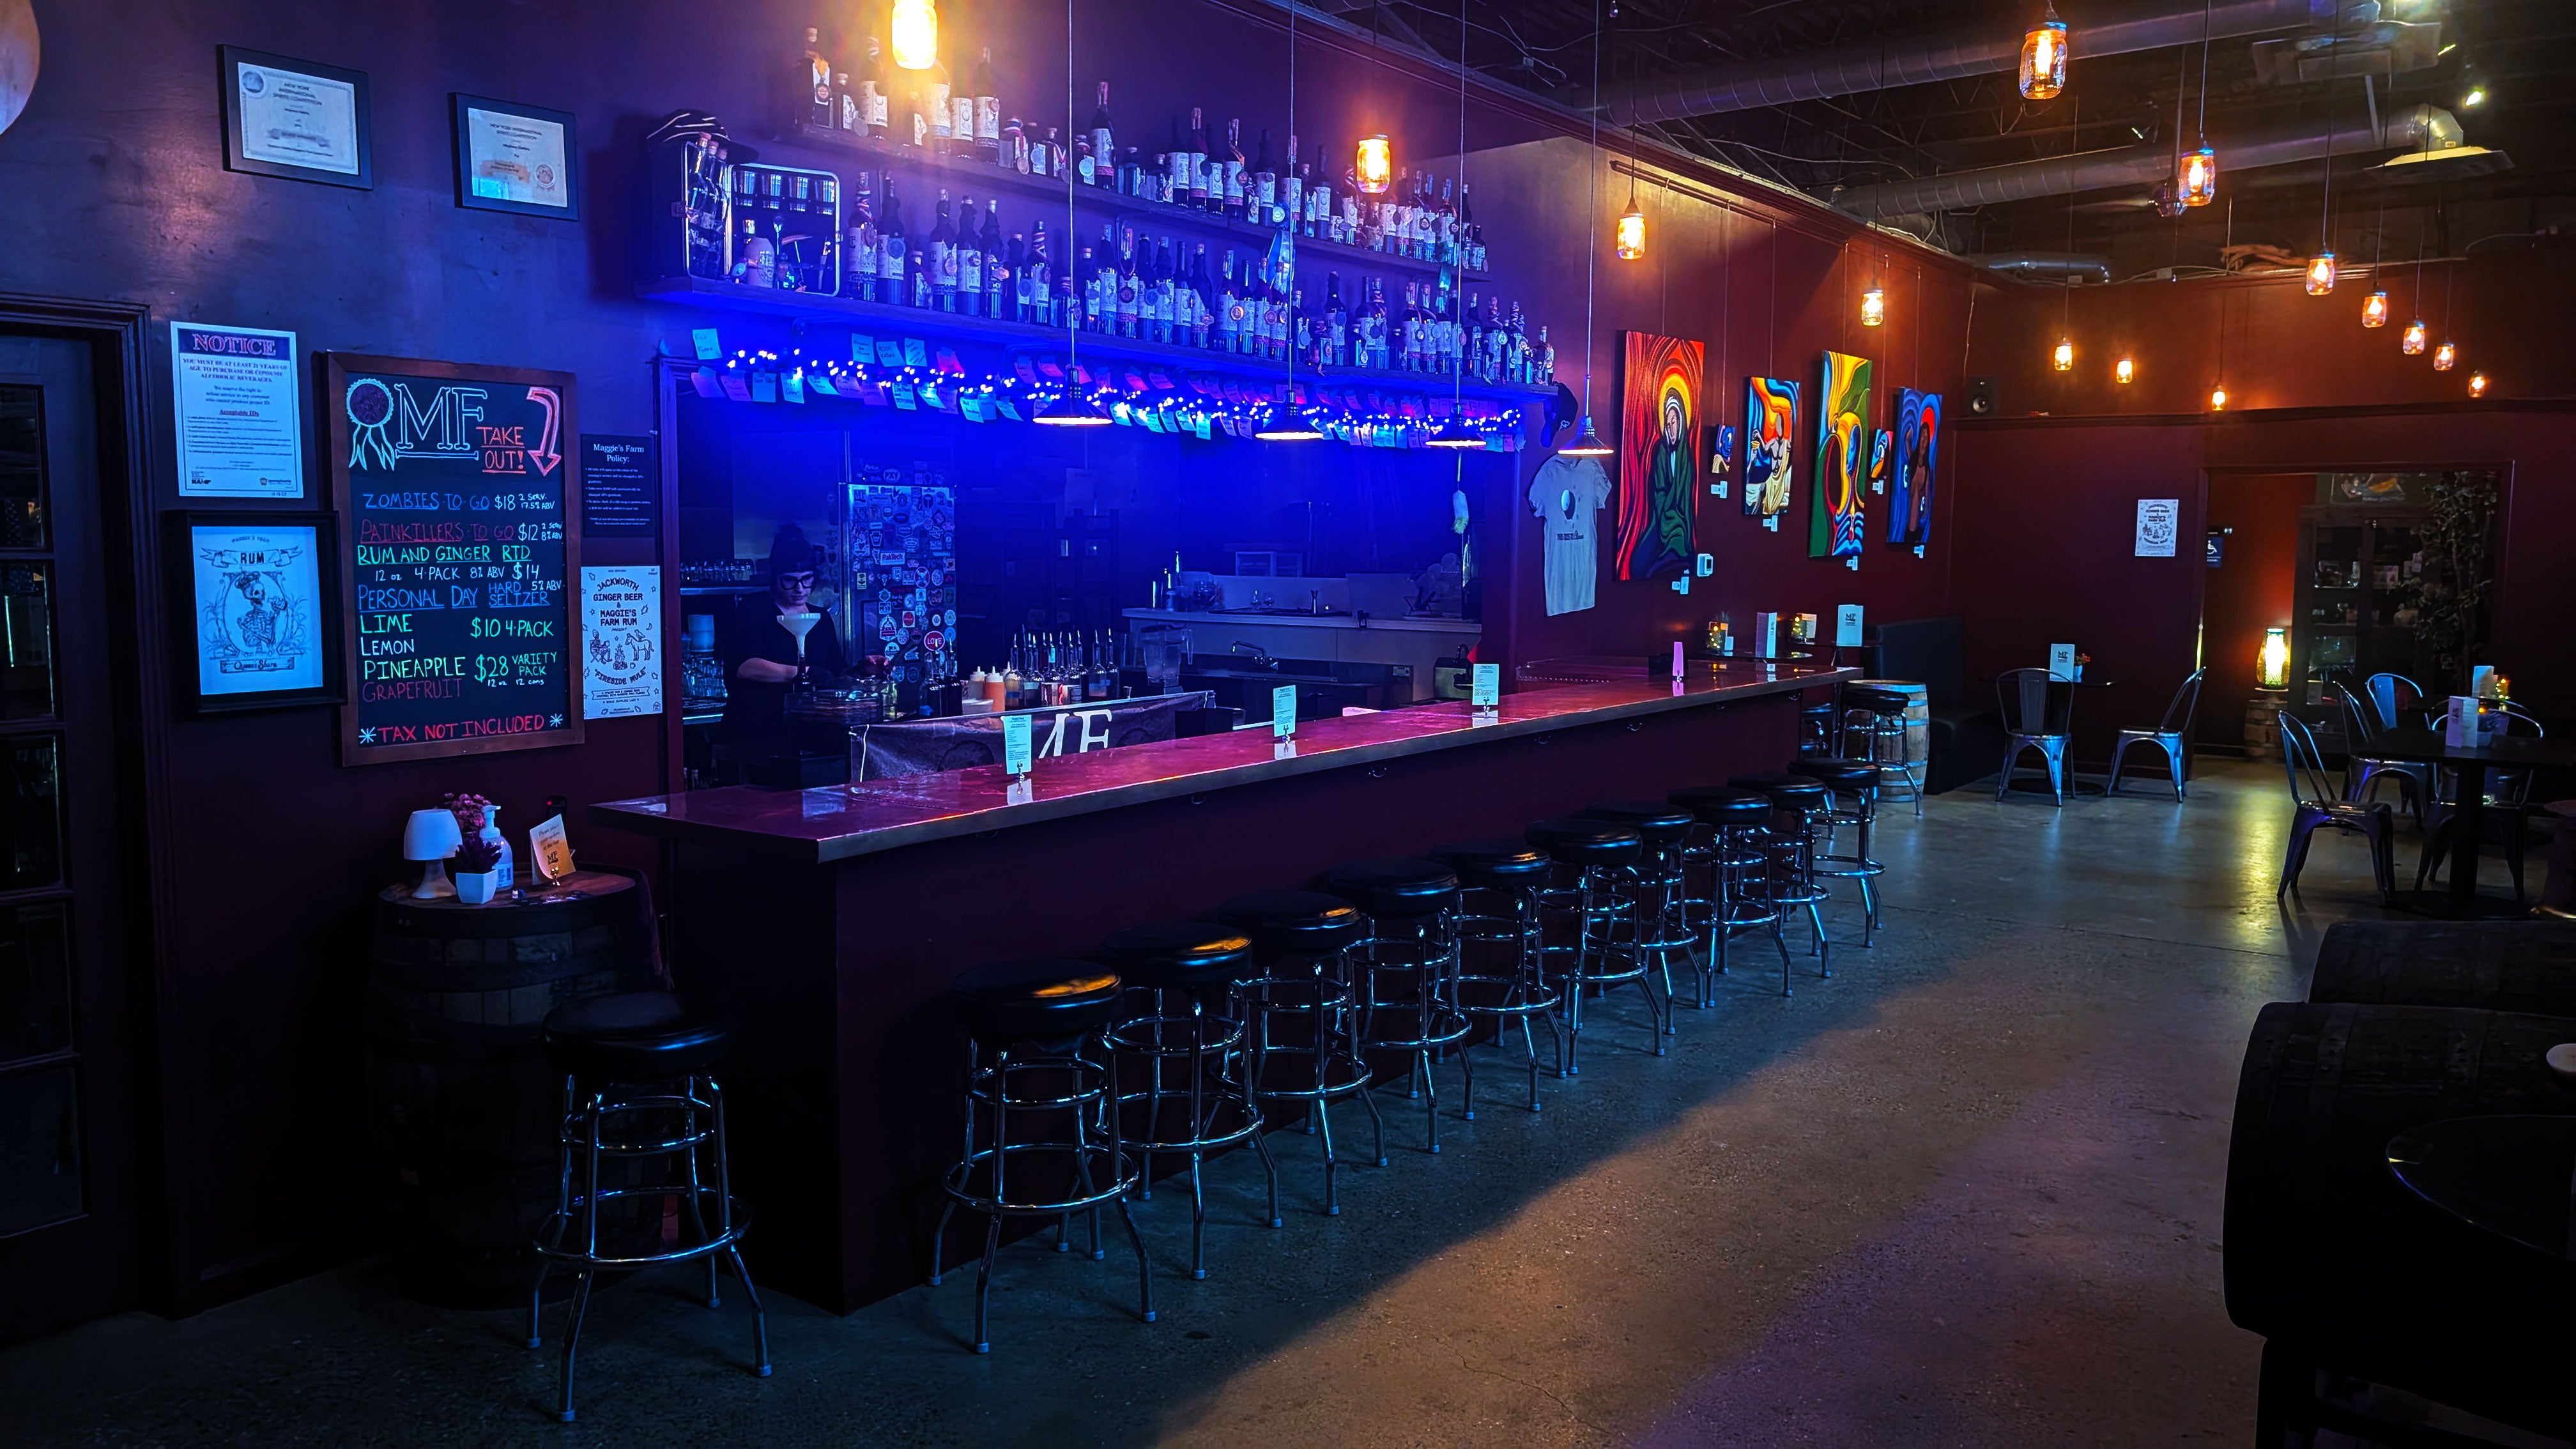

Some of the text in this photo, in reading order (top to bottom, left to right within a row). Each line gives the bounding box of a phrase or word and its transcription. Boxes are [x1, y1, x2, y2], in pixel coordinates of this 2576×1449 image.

[192, 333, 276, 356] NOTICE
[394, 383, 488, 450] MF
[476, 426, 525, 446] TAKE
[593, 443, 645, 454] Maggie's Farm
[485, 450, 524, 470] OUT!
[606, 454, 630, 464] Policy:
[494, 494, 516, 510] $18
[518, 493, 524, 502] 2
[541, 501, 555, 510] ABV
[360, 519, 539, 542] PAINKILLERS TO GO $12
[540, 531, 563, 542] 8% ABV
[240, 551, 264, 564] RUM
[357, 544, 530, 564] RUM AND GINGER RTD
[375, 569, 385, 581] 12
[470, 567, 483, 578] 8%
[487, 566, 505, 578] ABV
[512, 562, 540, 581] $14
[597, 577, 640, 592] JACKWORTH
[358, 580, 562, 610] PERSONAL DAY HARD 5% ABV
[489, 591, 550, 606] SELTZER
[593, 592, 643, 602] GINGER BEER
[600, 609, 637, 618] MAGGIE'S
[600, 617, 638, 626] FARM RUM
[360, 613, 413, 634] LIME
[470, 617, 501, 639] $10
[360, 636, 415, 657] LEMON
[364, 652, 557, 683] PINEAPPLE $28 VARIETY
[519, 666, 547, 677] PACK
[362, 678, 463, 703] GRAPEFRUIT
[487, 679, 496, 687] 12
[377, 714, 545, 743] TAX NOT INCLUDED
